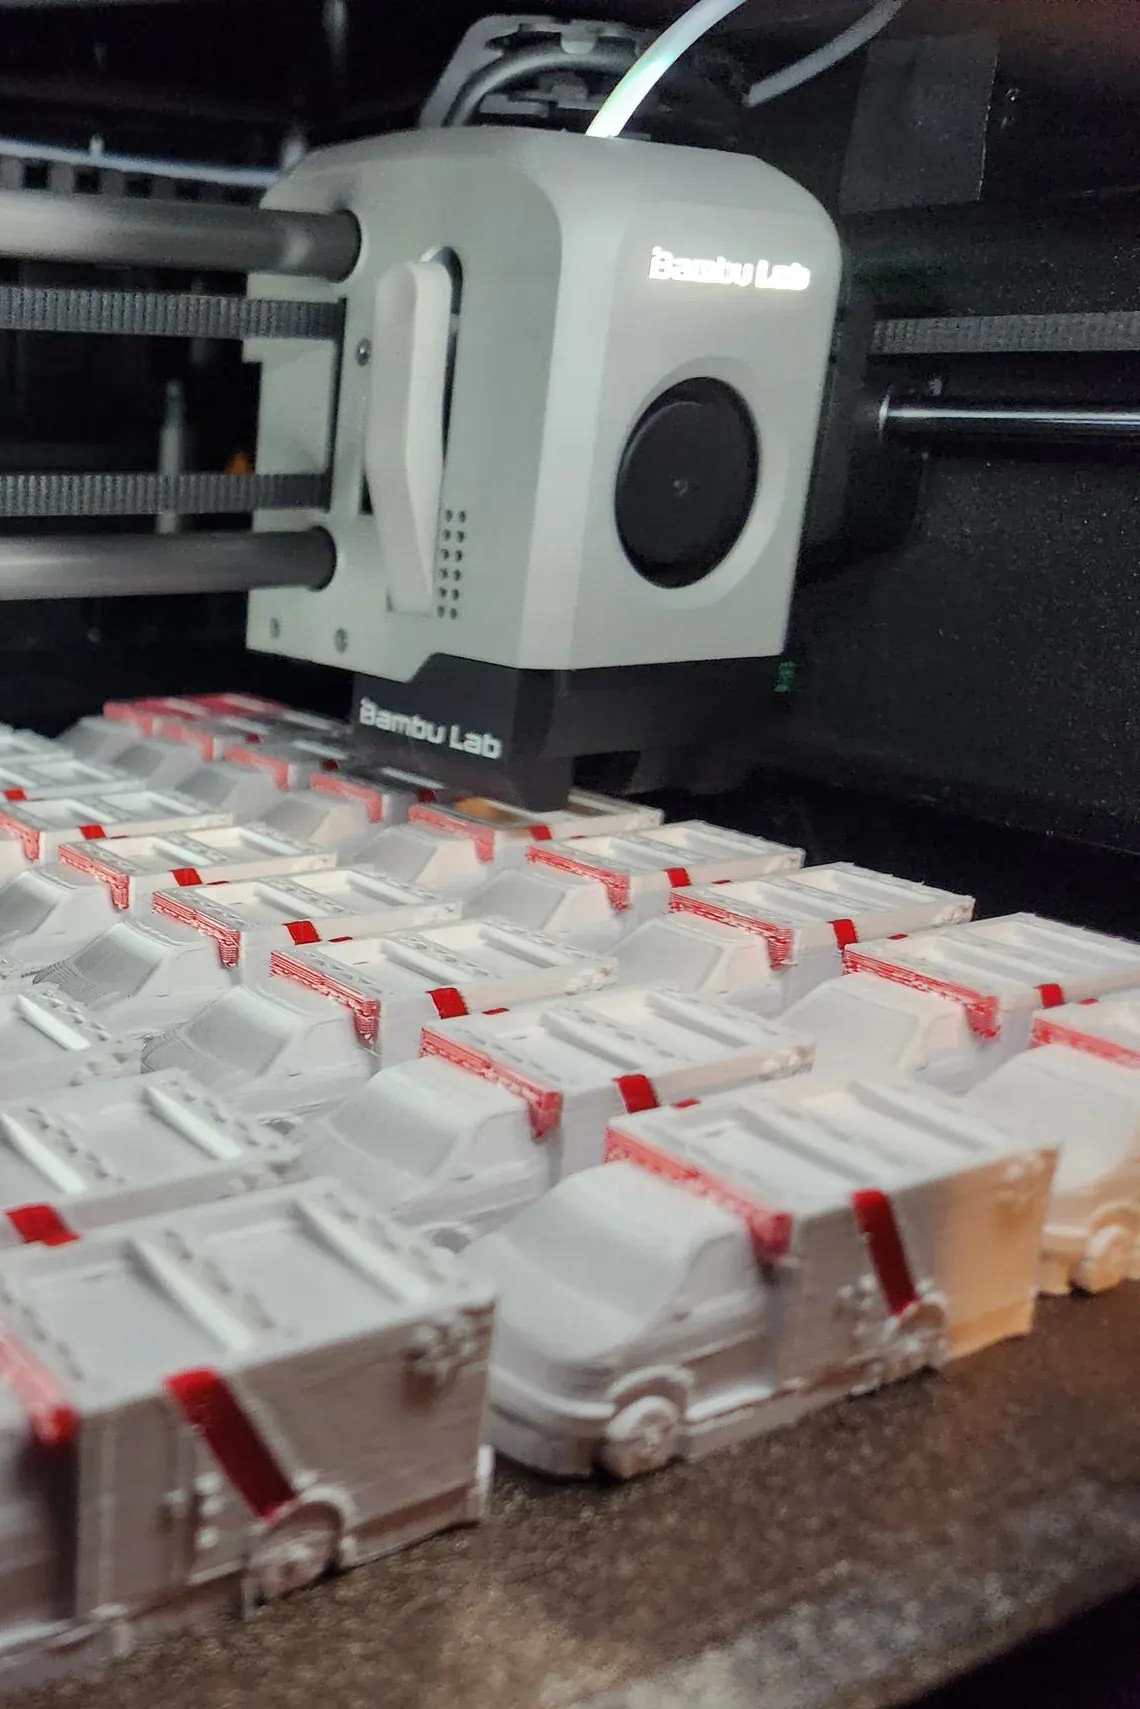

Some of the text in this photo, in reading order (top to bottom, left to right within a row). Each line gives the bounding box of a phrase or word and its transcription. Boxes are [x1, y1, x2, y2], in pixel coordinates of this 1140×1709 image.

[649, 246, 754, 286] Bambu
[360, 697, 503, 760] Bambu Lab
